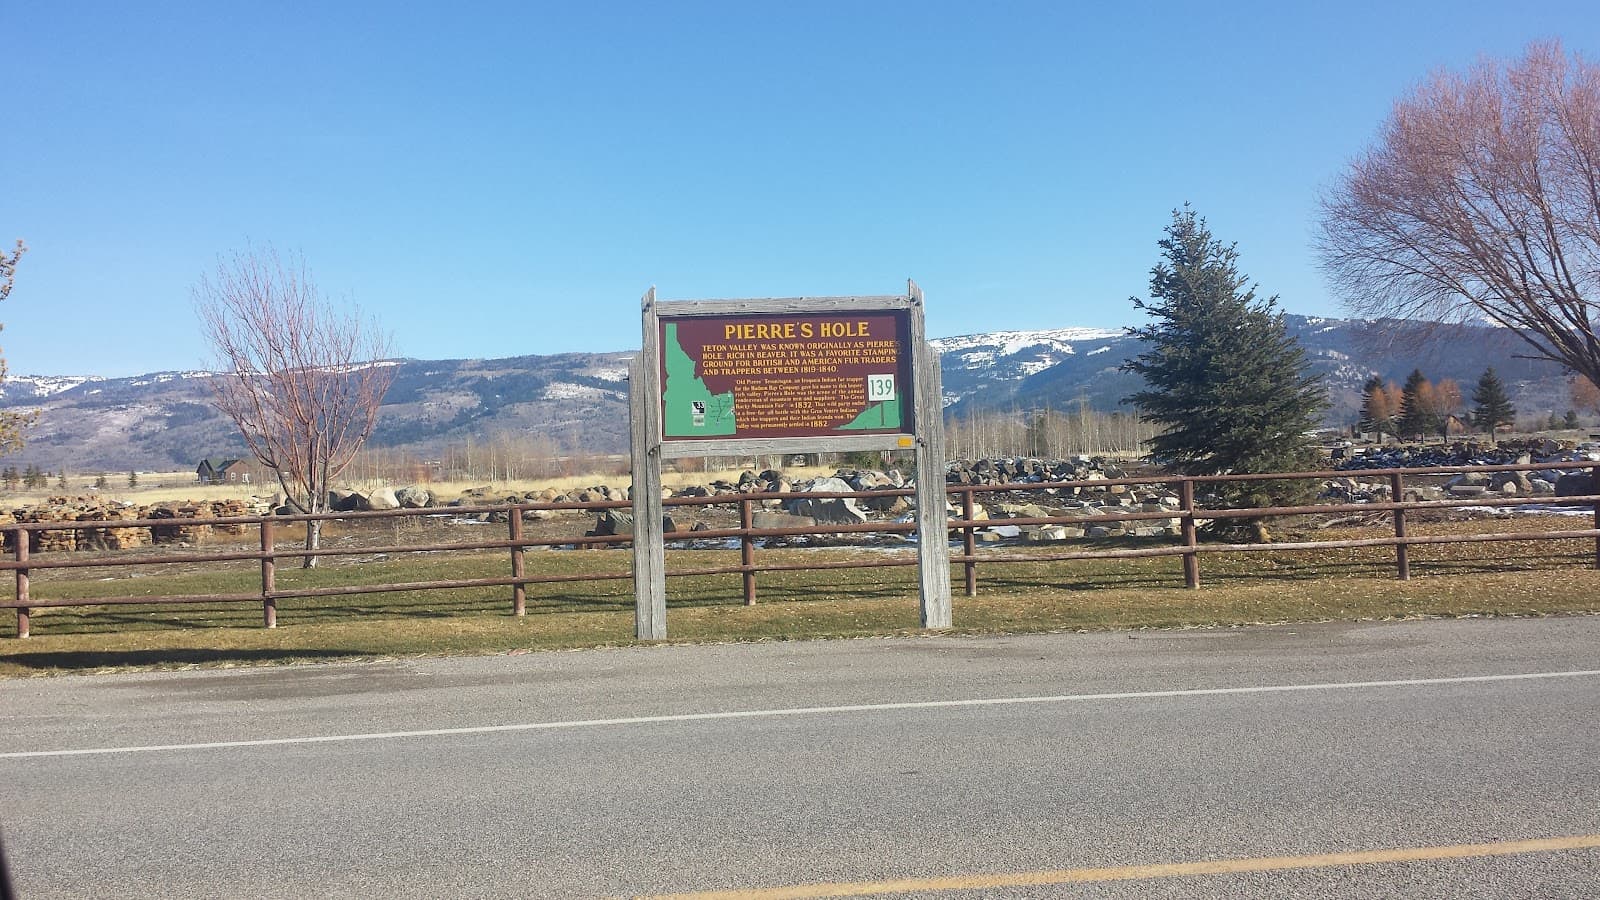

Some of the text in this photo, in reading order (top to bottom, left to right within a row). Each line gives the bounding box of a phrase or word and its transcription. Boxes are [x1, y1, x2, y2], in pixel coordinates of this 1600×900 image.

[725, 322, 870, 340] PIERRE'S HOLE
[806, 342, 851, 350] ORIGINALLY
[802, 358, 842, 366] AMERICAN
[862, 356, 896, 364] TRADERS
[720, 367, 762, 375] TRAPPERS
[763, 366, 799, 374] BETWEEN
[870, 380, 892, 396] 139
